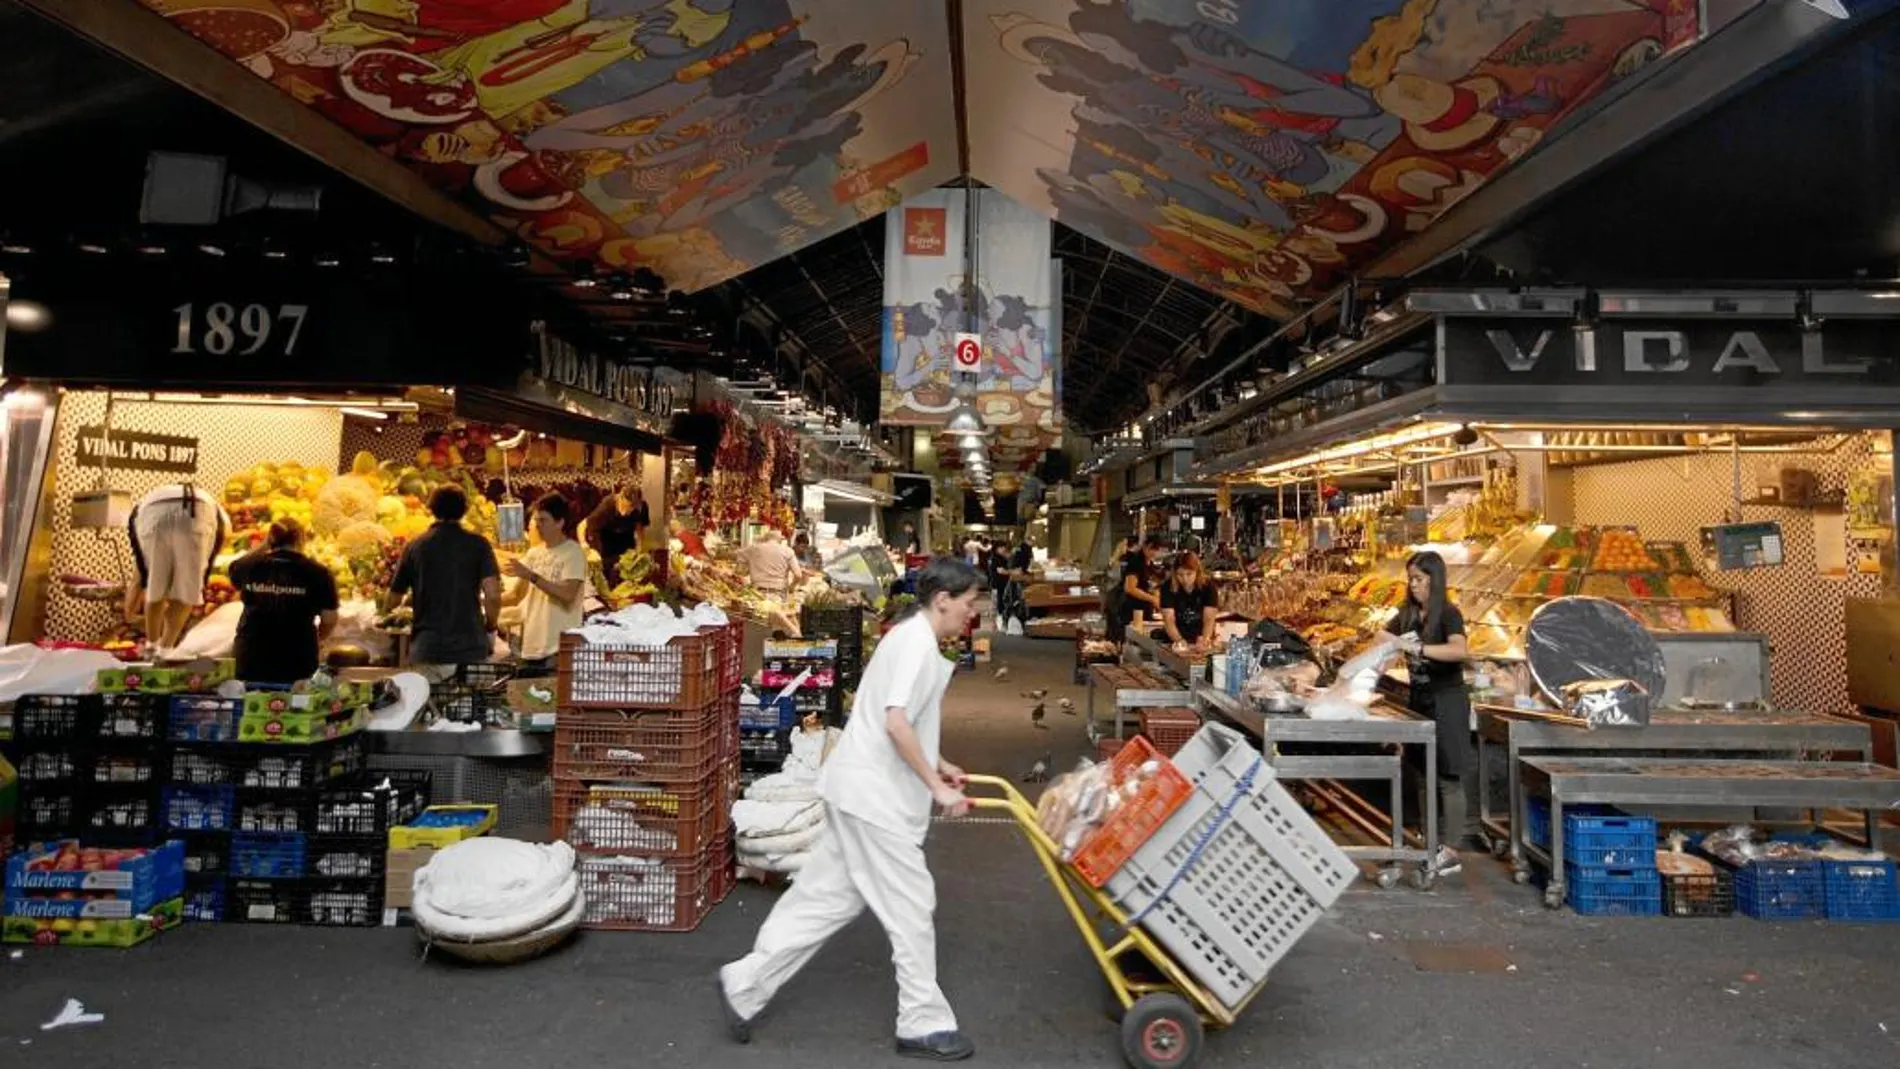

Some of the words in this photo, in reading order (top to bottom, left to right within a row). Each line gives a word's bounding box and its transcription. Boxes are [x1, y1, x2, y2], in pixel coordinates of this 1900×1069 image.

[170, 302, 308, 356] 1897
[530, 319, 602, 397] VIDAL
[963, 343, 974, 362] 6
[1485, 330, 1869, 373] VIDAL
[83, 437, 128, 459] VIDAL
[131, 441, 167, 462] PONS
[169, 445, 195, 464] 1897
[12, 871, 77, 889] Marlene
[11, 901, 76, 918] Marlene
